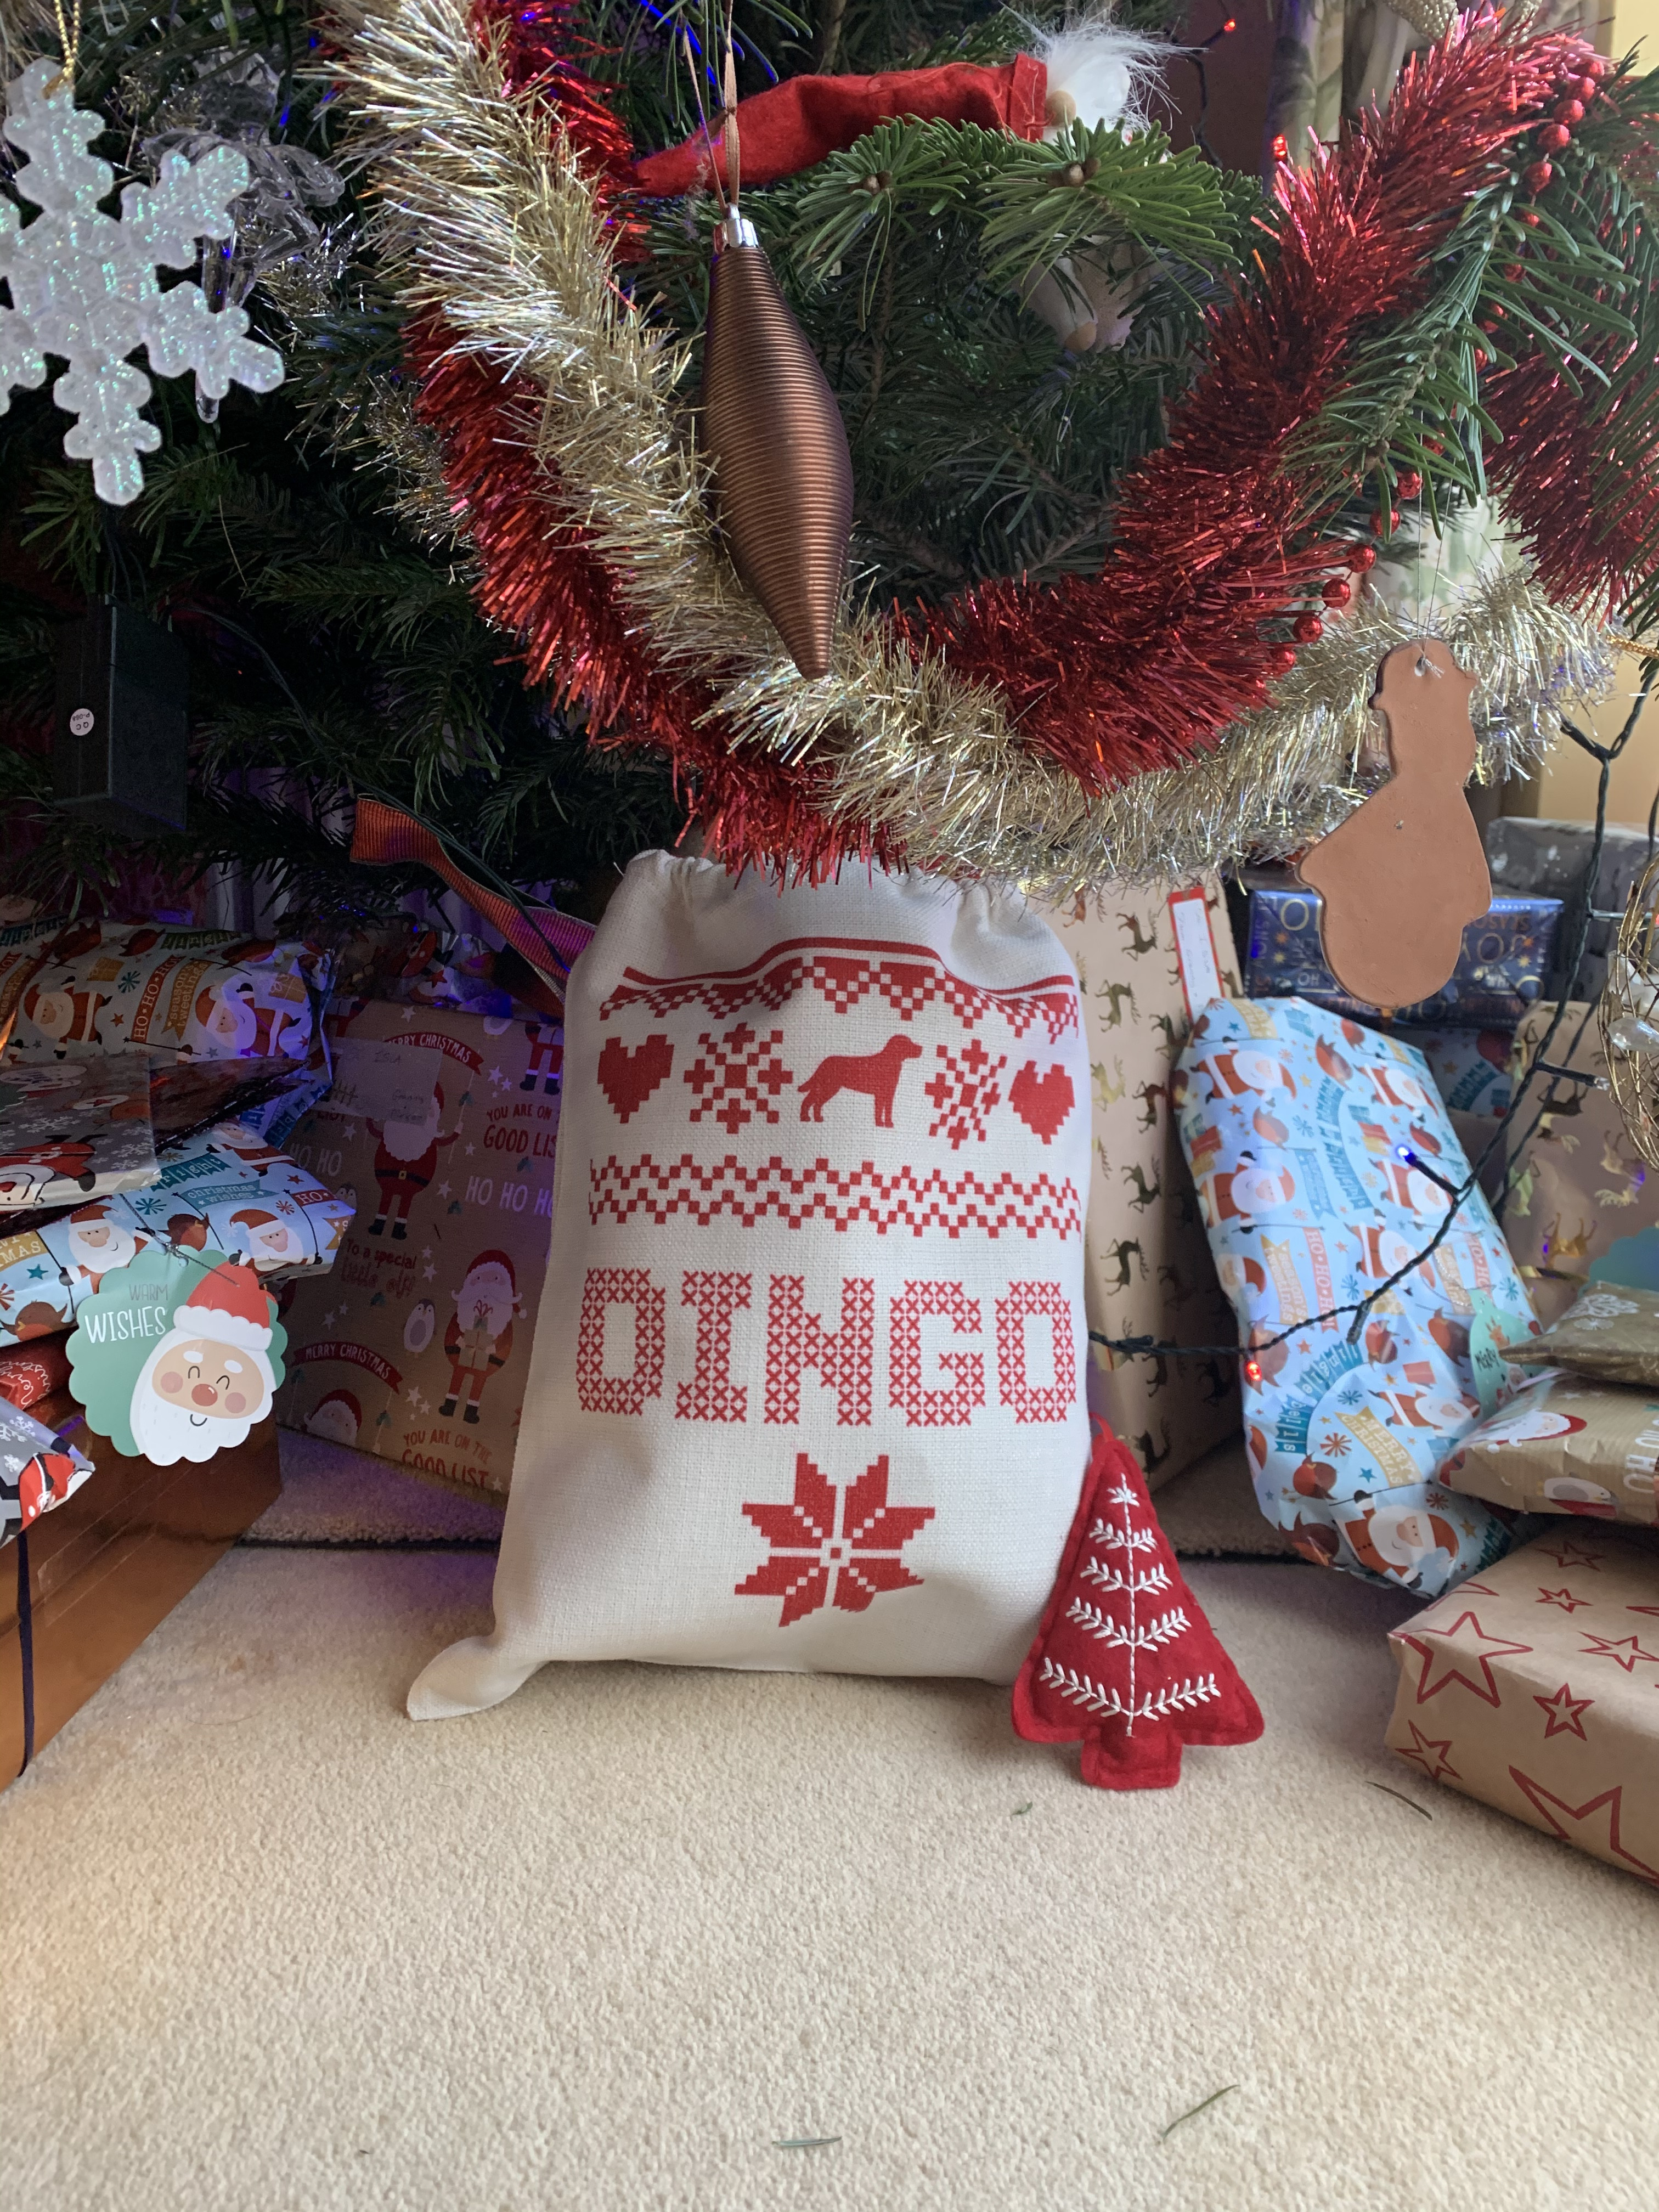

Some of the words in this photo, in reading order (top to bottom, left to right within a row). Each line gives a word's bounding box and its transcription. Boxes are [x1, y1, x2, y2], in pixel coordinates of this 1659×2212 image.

[419, 1034, 471, 1063] CHRISTMAS
[486, 1105, 508, 1121] YOU
[513, 1103, 533, 1118] ARE
[537, 1105, 552, 1120] ON
[483, 1124, 529, 1154] GOOD
[161, 1157, 221, 1183] right
[317, 1148, 342, 1177] HO
[187, 1183, 256, 1199] christmas
[209, 1189, 255, 1204] wishes
[465, 1175, 493, 1206] HO
[499, 1181, 528, 1212] HO
[374, 1250, 417, 1269] special
[129, 1283, 168, 1301] WARM
[84, 1306, 167, 1344] WISHES
[577, 1268, 1076, 1426] DINGO
[1475, 1347, 1500, 1371] MERRY
[306, 1344, 336, 1360] MERRY
[340, 1344, 391, 1380] CHRISTMAS
[403, 1430, 426, 1447] YOU
[430, 1429, 451, 1445] ARE
[454, 1434, 471, 1450] ON
[1341, 1415, 1403, 1484] CHRISTMAS
[1363, 1419, 1416, 1472] MERRY
